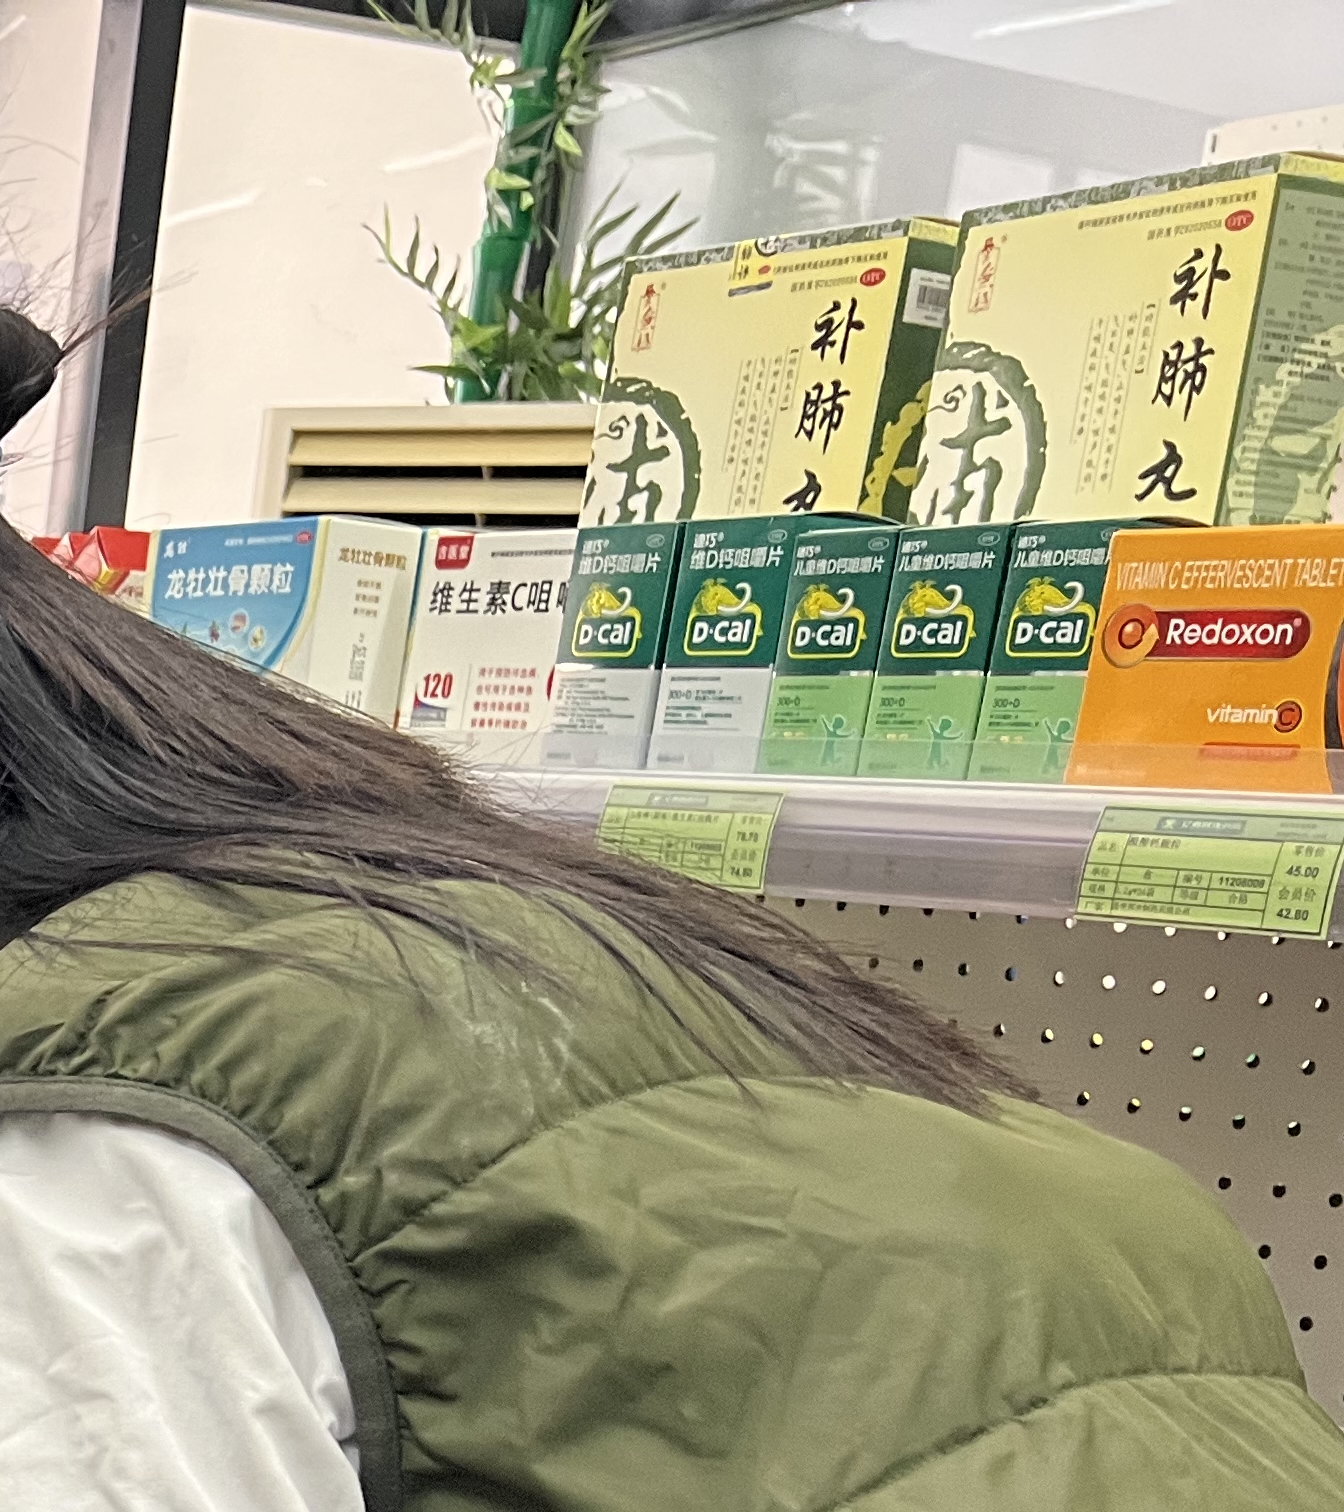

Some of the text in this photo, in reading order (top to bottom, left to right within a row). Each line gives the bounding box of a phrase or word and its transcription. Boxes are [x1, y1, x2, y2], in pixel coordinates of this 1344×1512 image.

[1135, 243, 1232, 503] 补肺丸
[337, 547, 408, 571] 龙牡壮骨颗粒
[164, 562, 295, 599] 龙牡壮骨颗粒
[1116, 563, 1166, 590] VITAMIN
[1168, 562, 1181, 588] C
[1181, 559, 1292, 589] EFFERVESCENT
[1165, 618, 1293, 645] Redoxon
[422, 672, 453, 699] 120
[1286, 865, 1320, 879] 45.00
[1276, 908, 1309, 921] 42.80
